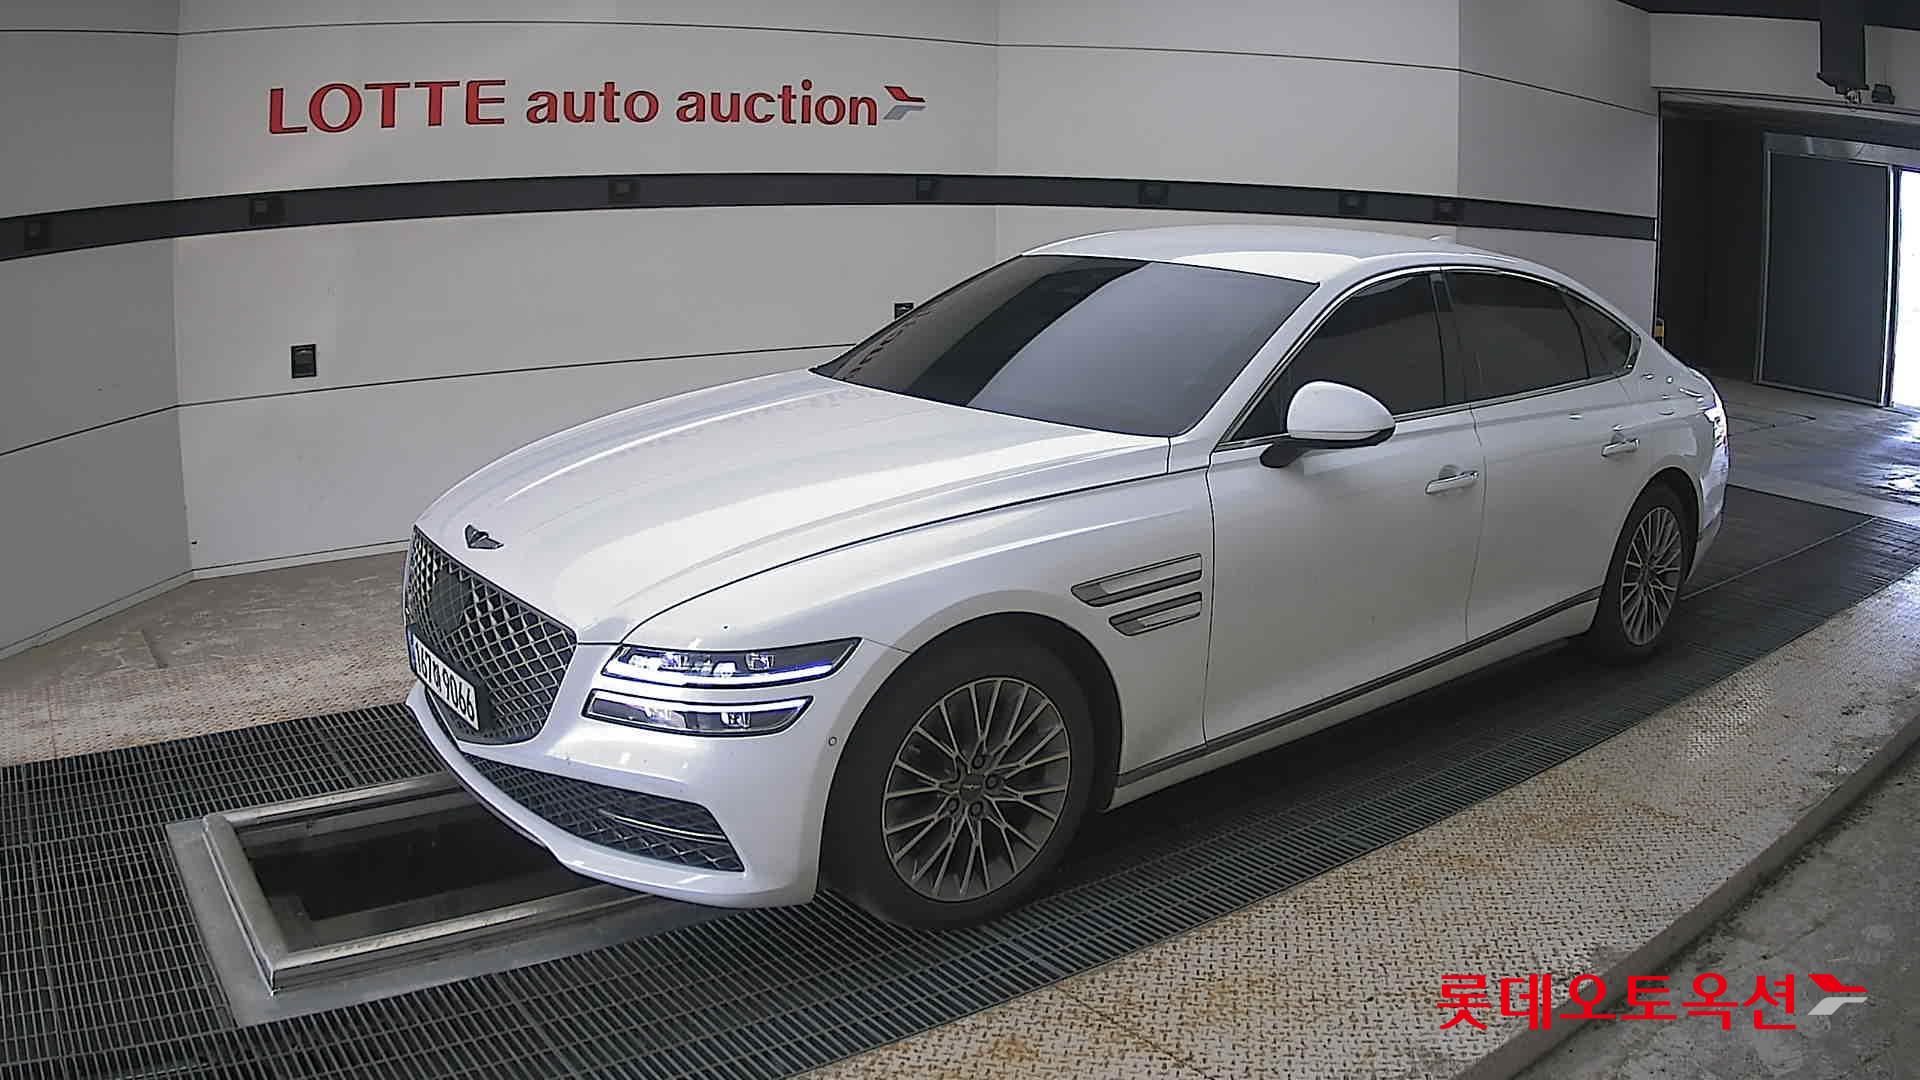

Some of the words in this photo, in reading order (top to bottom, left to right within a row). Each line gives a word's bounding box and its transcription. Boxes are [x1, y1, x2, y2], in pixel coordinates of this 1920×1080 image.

[268, 80, 506, 134] LOTTE
[526, 81, 660, 124] auto
[676, 79, 878, 126] auction
